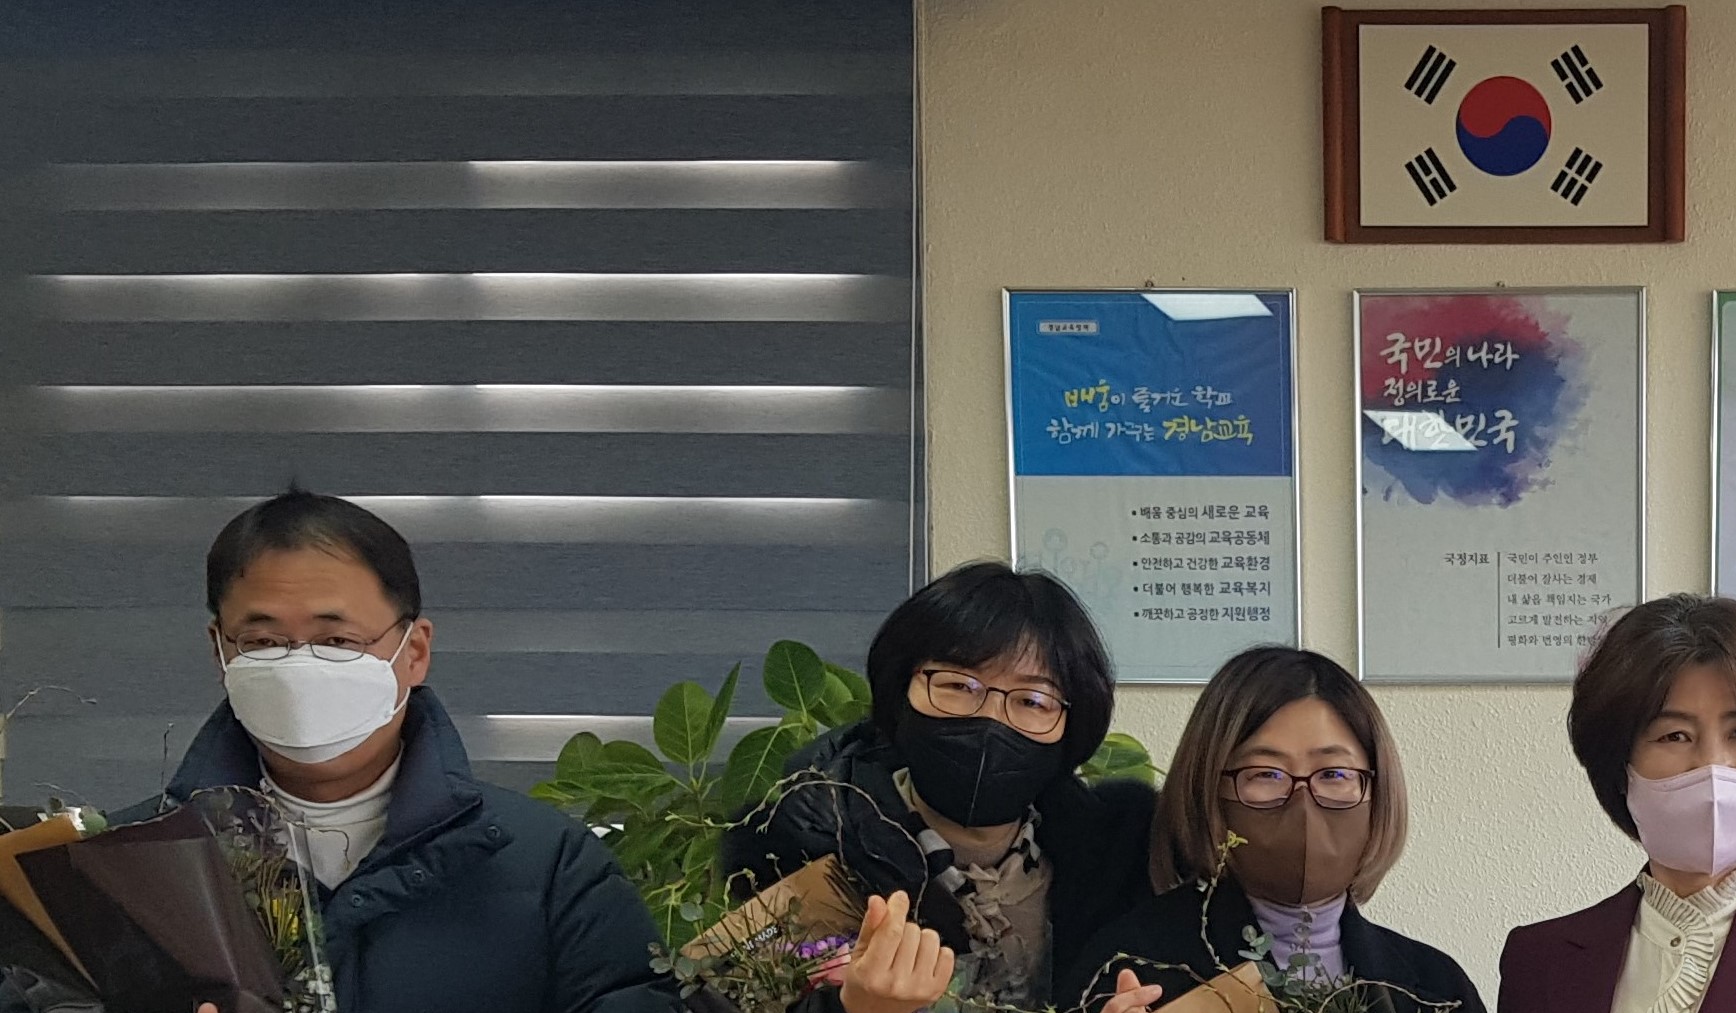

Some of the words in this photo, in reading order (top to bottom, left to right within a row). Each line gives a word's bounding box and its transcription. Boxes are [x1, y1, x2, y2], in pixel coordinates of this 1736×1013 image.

[1379, 331, 1460, 375] 국민의
[1466, 340, 1521, 371] 나라
[1064, 378, 1126, 413] 배움이
[1131, 385, 1189, 413] 즐거운
[1191, 384, 1233, 409] 학교
[1382, 376, 1462, 407] 정의로운
[1046, 416, 1099, 445] 함께
[1104, 420, 1155, 442] 가꾸는
[1161, 413, 1254, 447] 경남교육
[1164, 506, 1199, 520] 중심의
[1200, 505, 1241, 520] 새로운
[1243, 505, 1270, 520] 교육
[1140, 531, 1173, 546] 소통과
[1174, 531, 1207, 546] 공감의
[1208, 530, 1271, 546] 교육공동체
[1140, 556, 1185, 571] 안전하고
[1186, 557, 1220, 571] 건강한
[1220, 555, 1271, 572] 교육환경
[1443, 552, 1491, 566] 국정지표
[1507, 552, 1539, 565] 국민이
[1542, 552, 1574, 565] 주인인
[1577, 552, 1599, 565] 정부
[1507, 573, 1539, 586] 더불어
[1142, 582, 1177, 597] 더불어
[1180, 582, 1215, 597] 행복한
[1218, 581, 1271, 598] 교육복지
[1590, 593, 1613, 606] 국가
[1141, 607, 1186, 621] 깨끗하고
[1186, 607, 1220, 622] 공정한
[1221, 606, 1271, 622] 지원행정
[1507, 614, 1539, 626] 고르게
[1542, 614, 1584, 627] 발전하는
[1507, 635, 1539, 647] 평화와
[1542, 635, 1573, 648] 번영의
